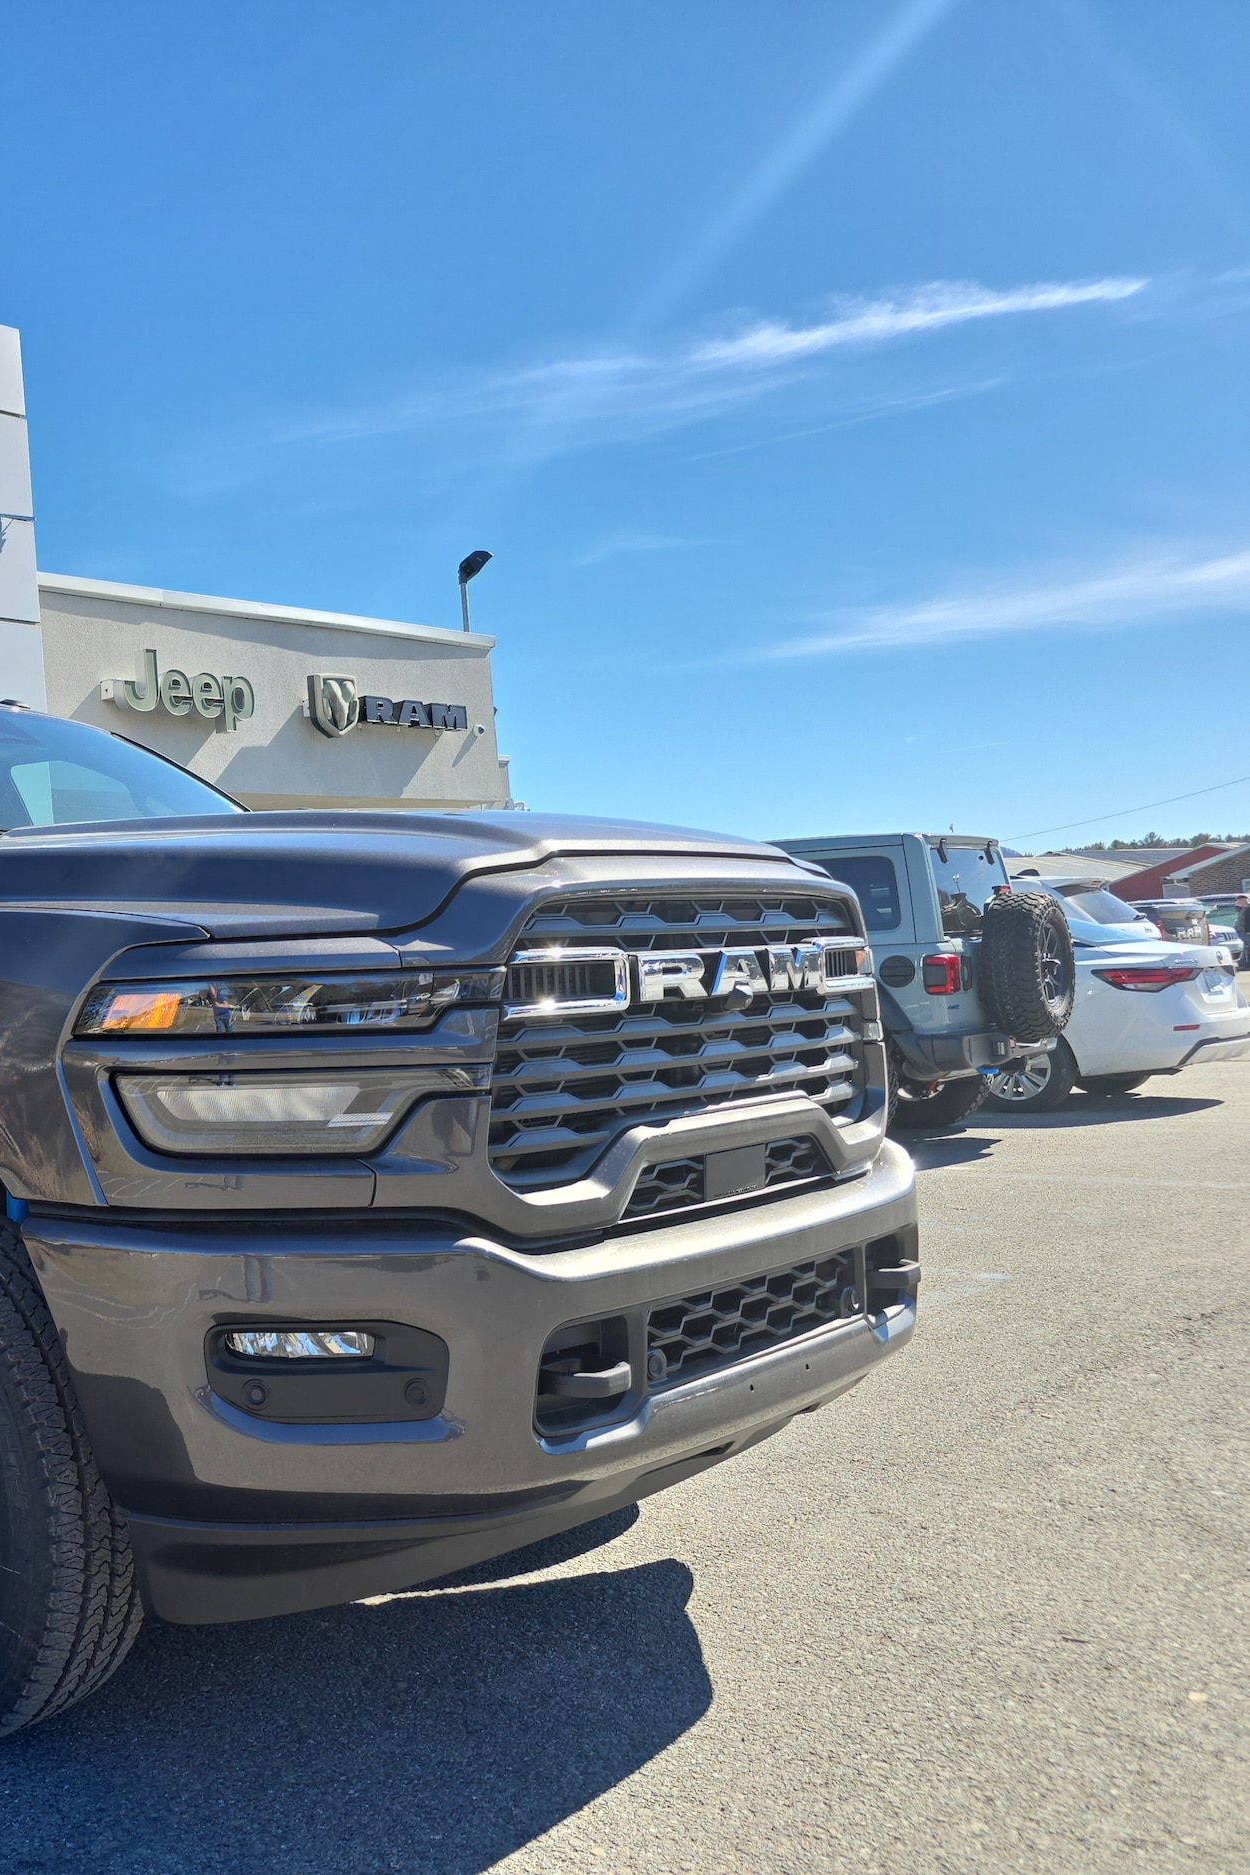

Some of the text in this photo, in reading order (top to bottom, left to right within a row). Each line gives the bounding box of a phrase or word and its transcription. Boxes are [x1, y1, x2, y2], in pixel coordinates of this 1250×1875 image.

[122, 648, 255, 733] Jeep
[359, 695, 468, 732] RAM
[638, 943, 824, 1001] RAM
